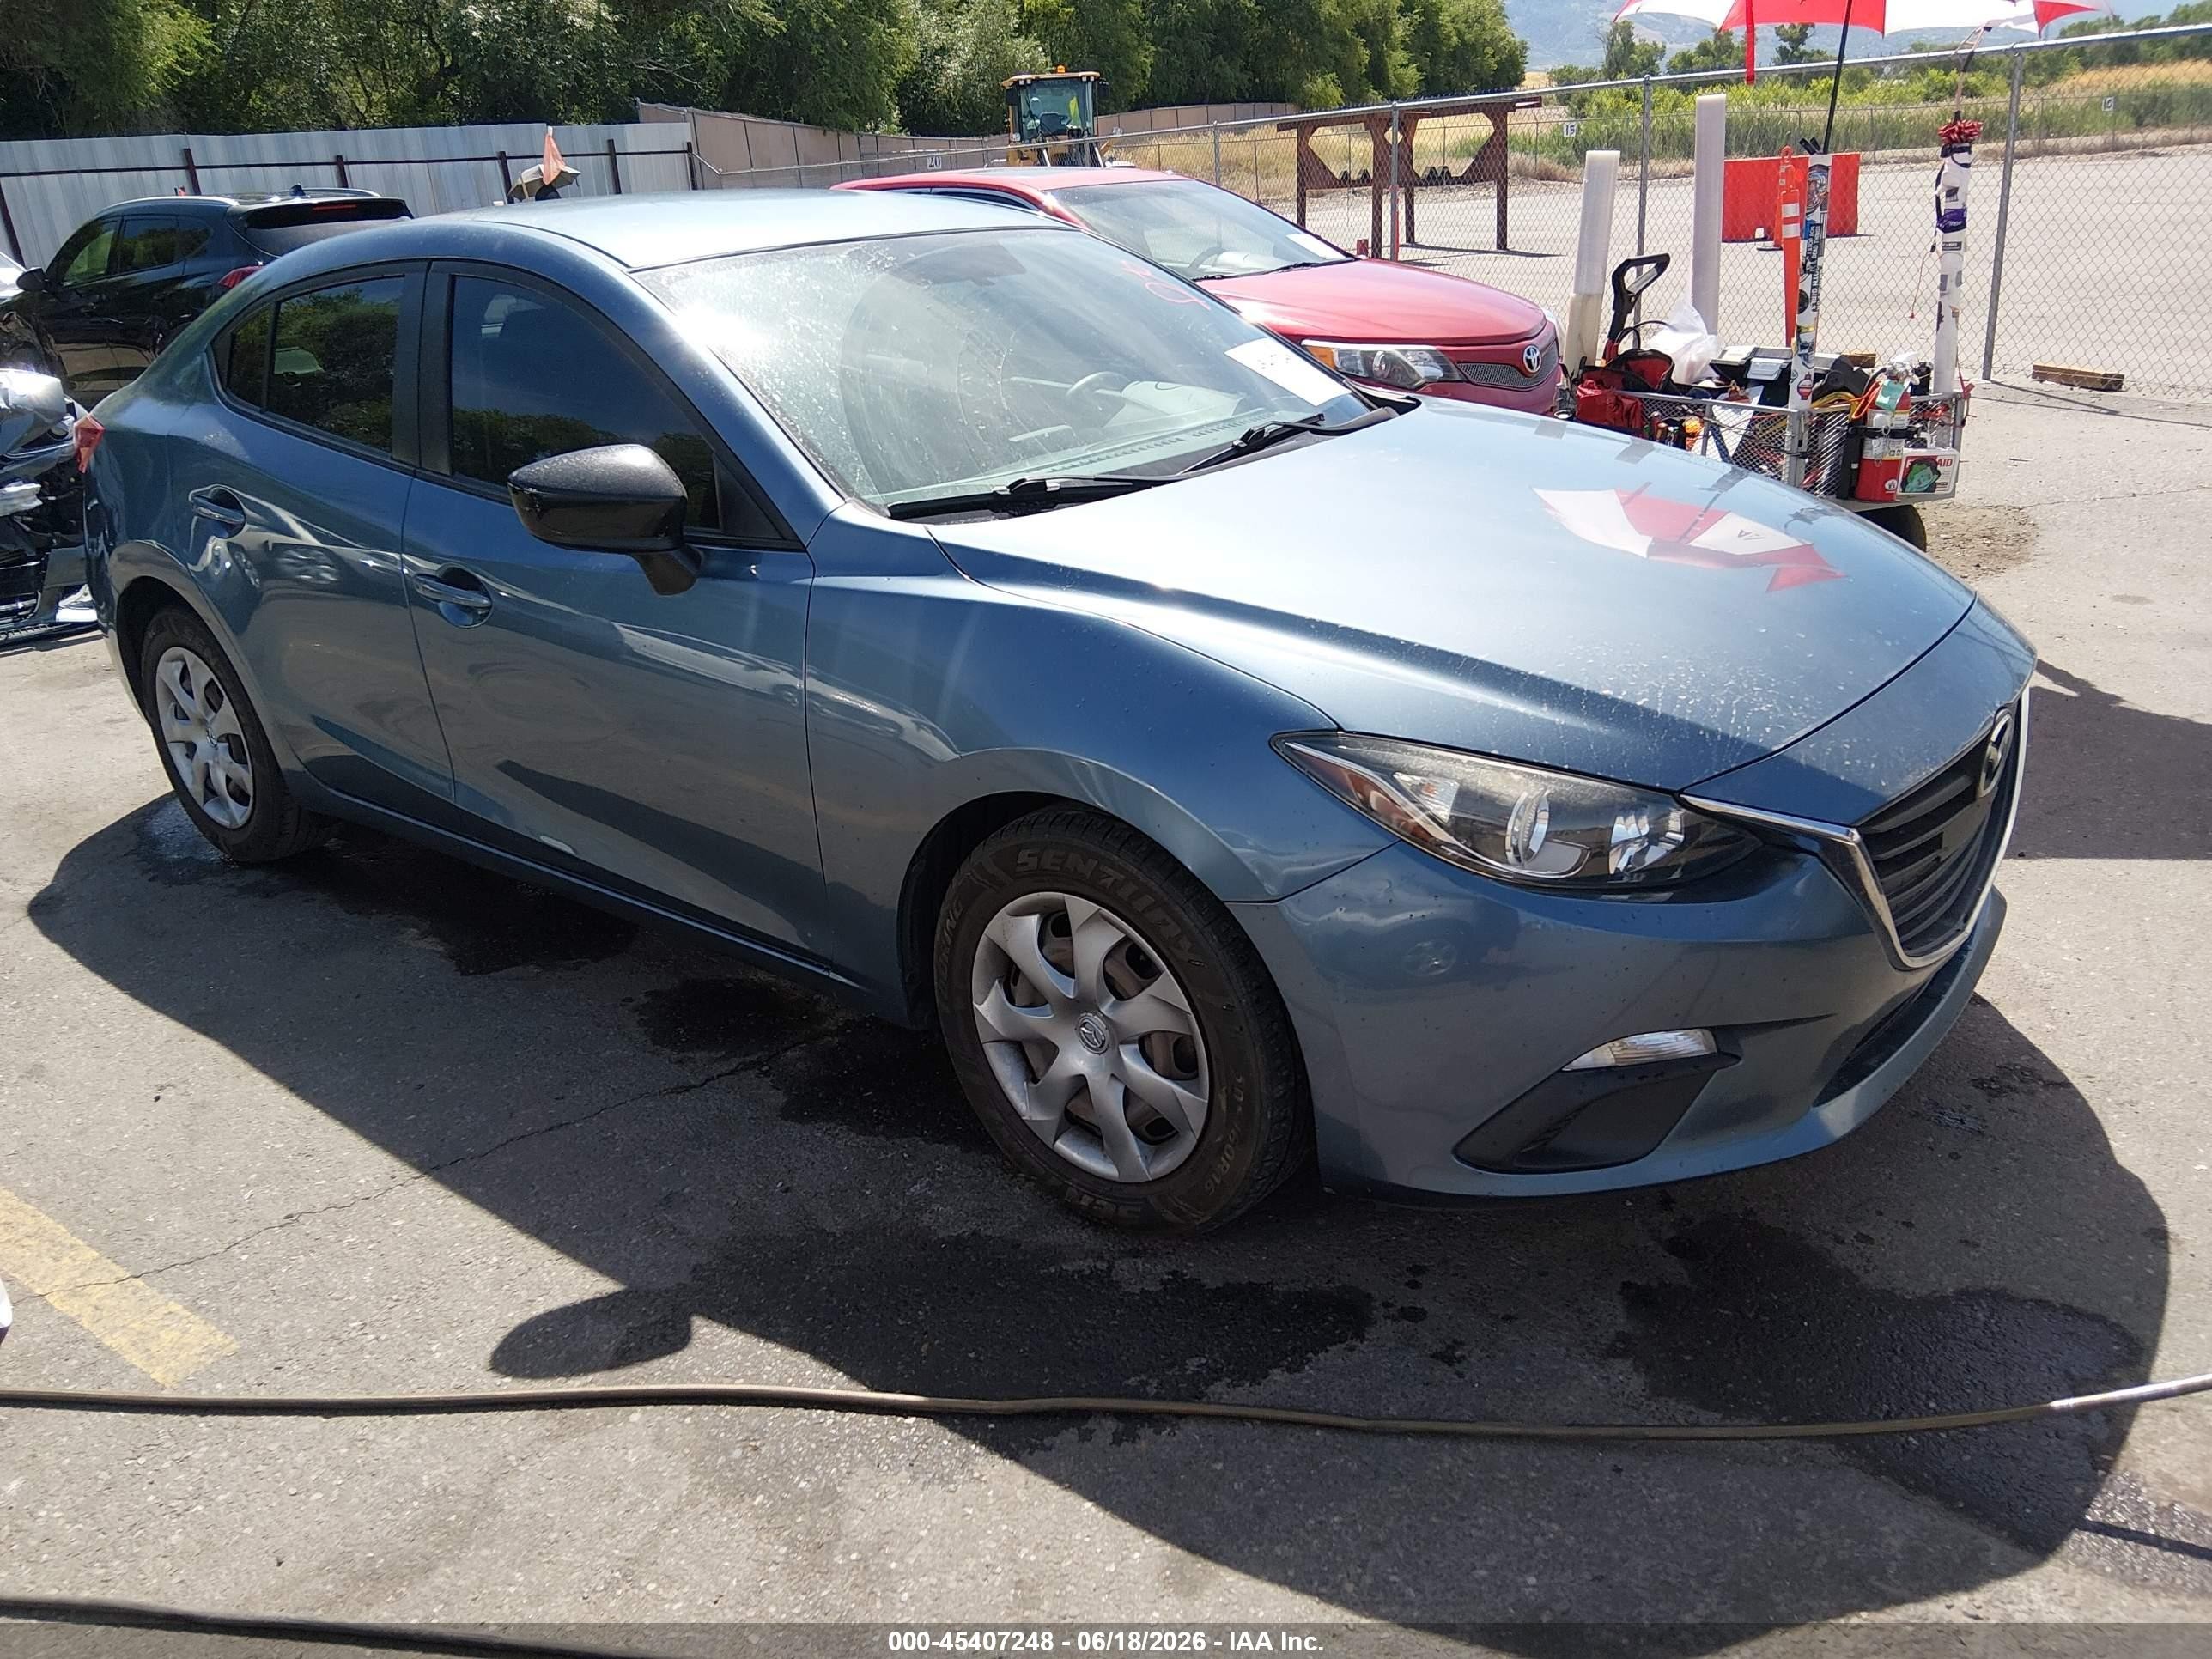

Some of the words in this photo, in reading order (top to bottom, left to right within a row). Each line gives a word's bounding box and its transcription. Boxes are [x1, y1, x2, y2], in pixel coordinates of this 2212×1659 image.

[1565, 125, 1575, 136] 15
[928, 156, 940, 168] 20
[1937, 459, 1953, 467] AID
